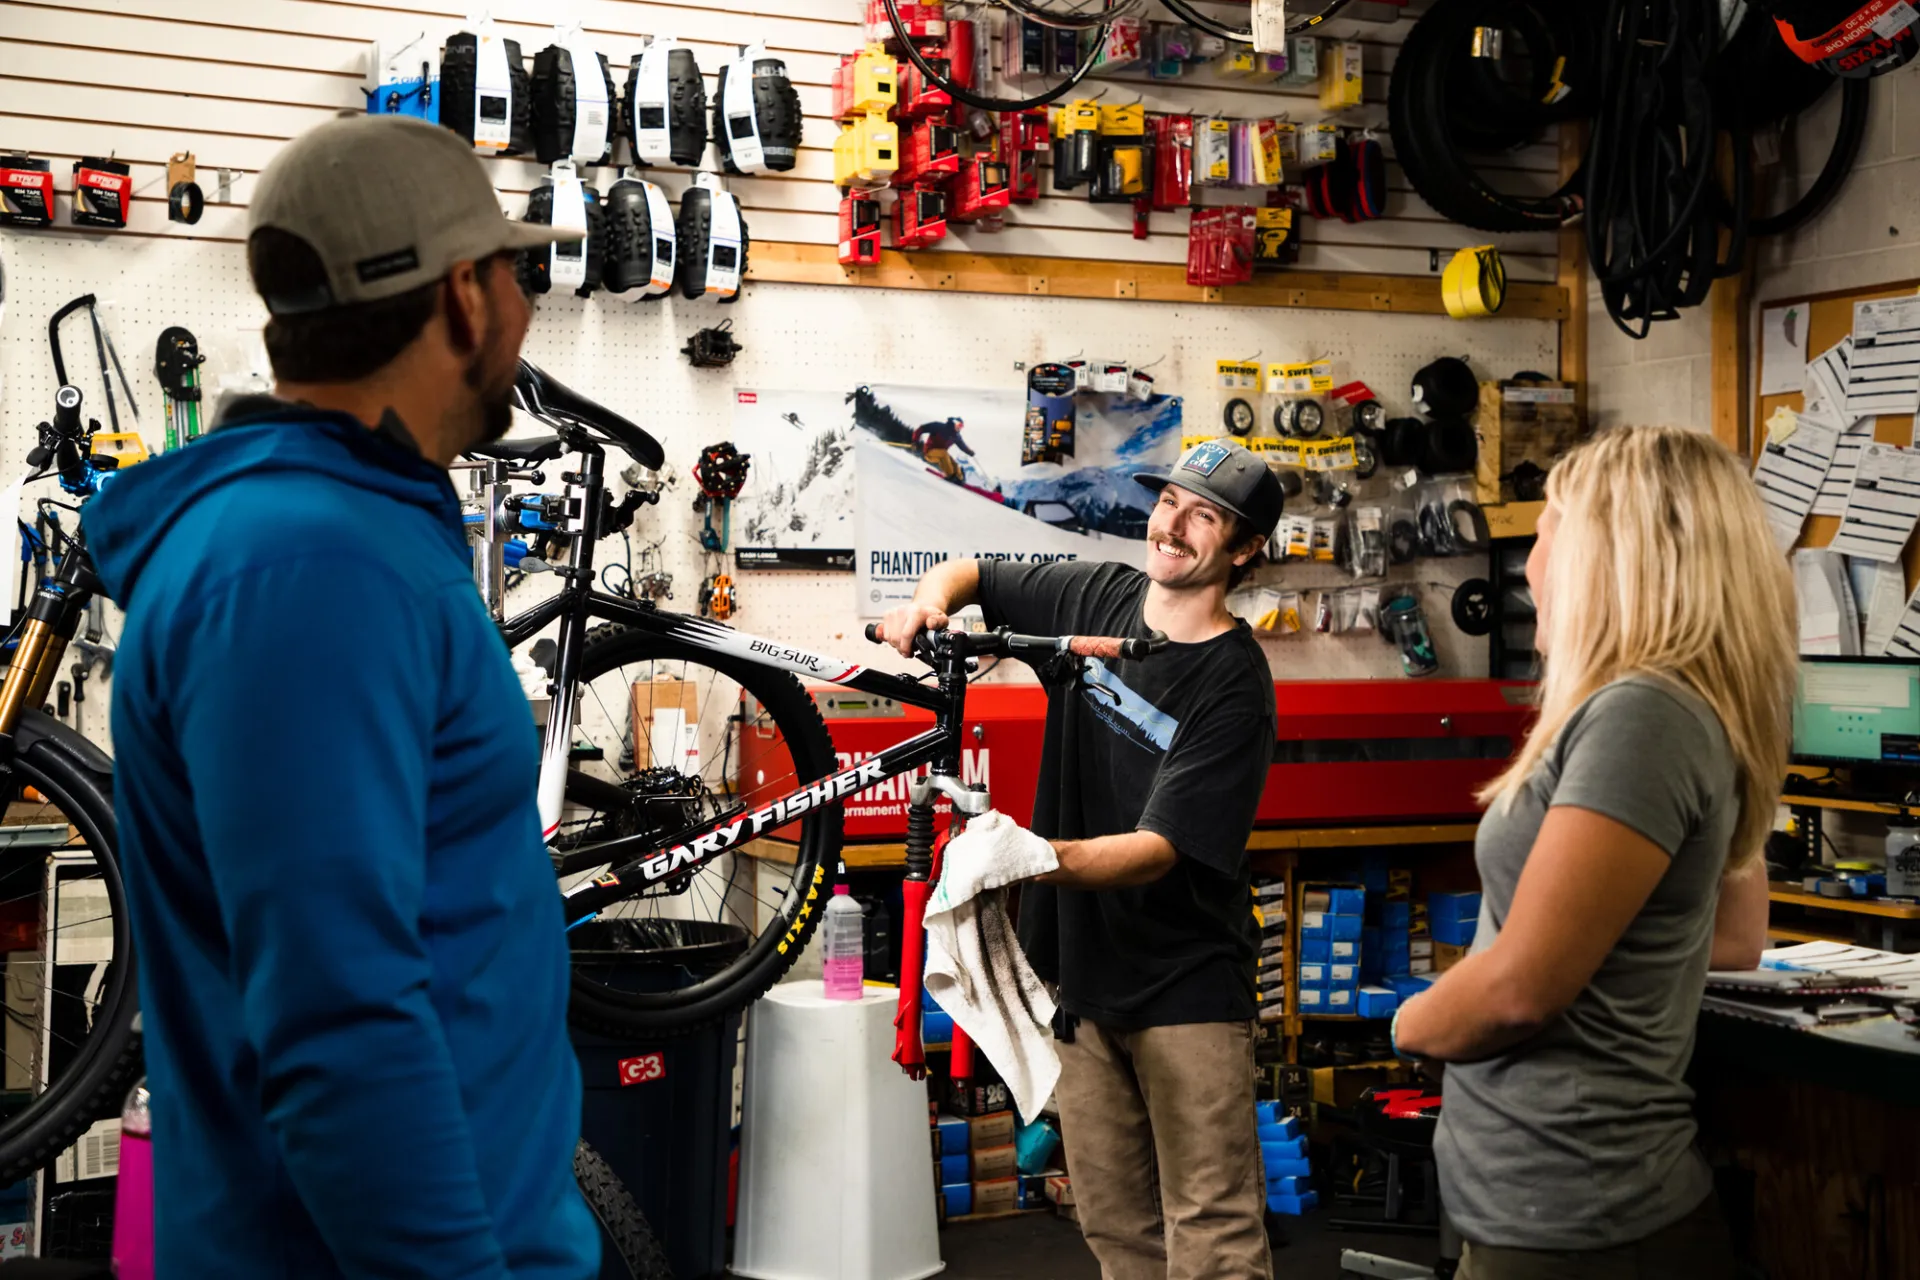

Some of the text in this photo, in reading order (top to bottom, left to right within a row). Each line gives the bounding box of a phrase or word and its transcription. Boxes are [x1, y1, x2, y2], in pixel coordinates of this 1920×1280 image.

[1824, 40, 1844, 53] DHF
[1219, 366, 1259, 375] SWENOR
[1202, 444, 1226, 455] SALTY
[1189, 459, 1209, 469] CREW
[749, 640, 819, 668] BIG SUR
[843, 805, 902, 817] ermanent
[639, 758, 887, 881] GARY FISHER
[777, 863, 825, 955] MAXXIS
[1288, 1072, 1300, 1083] 24
[986, 1083, 1006, 1105] 26
